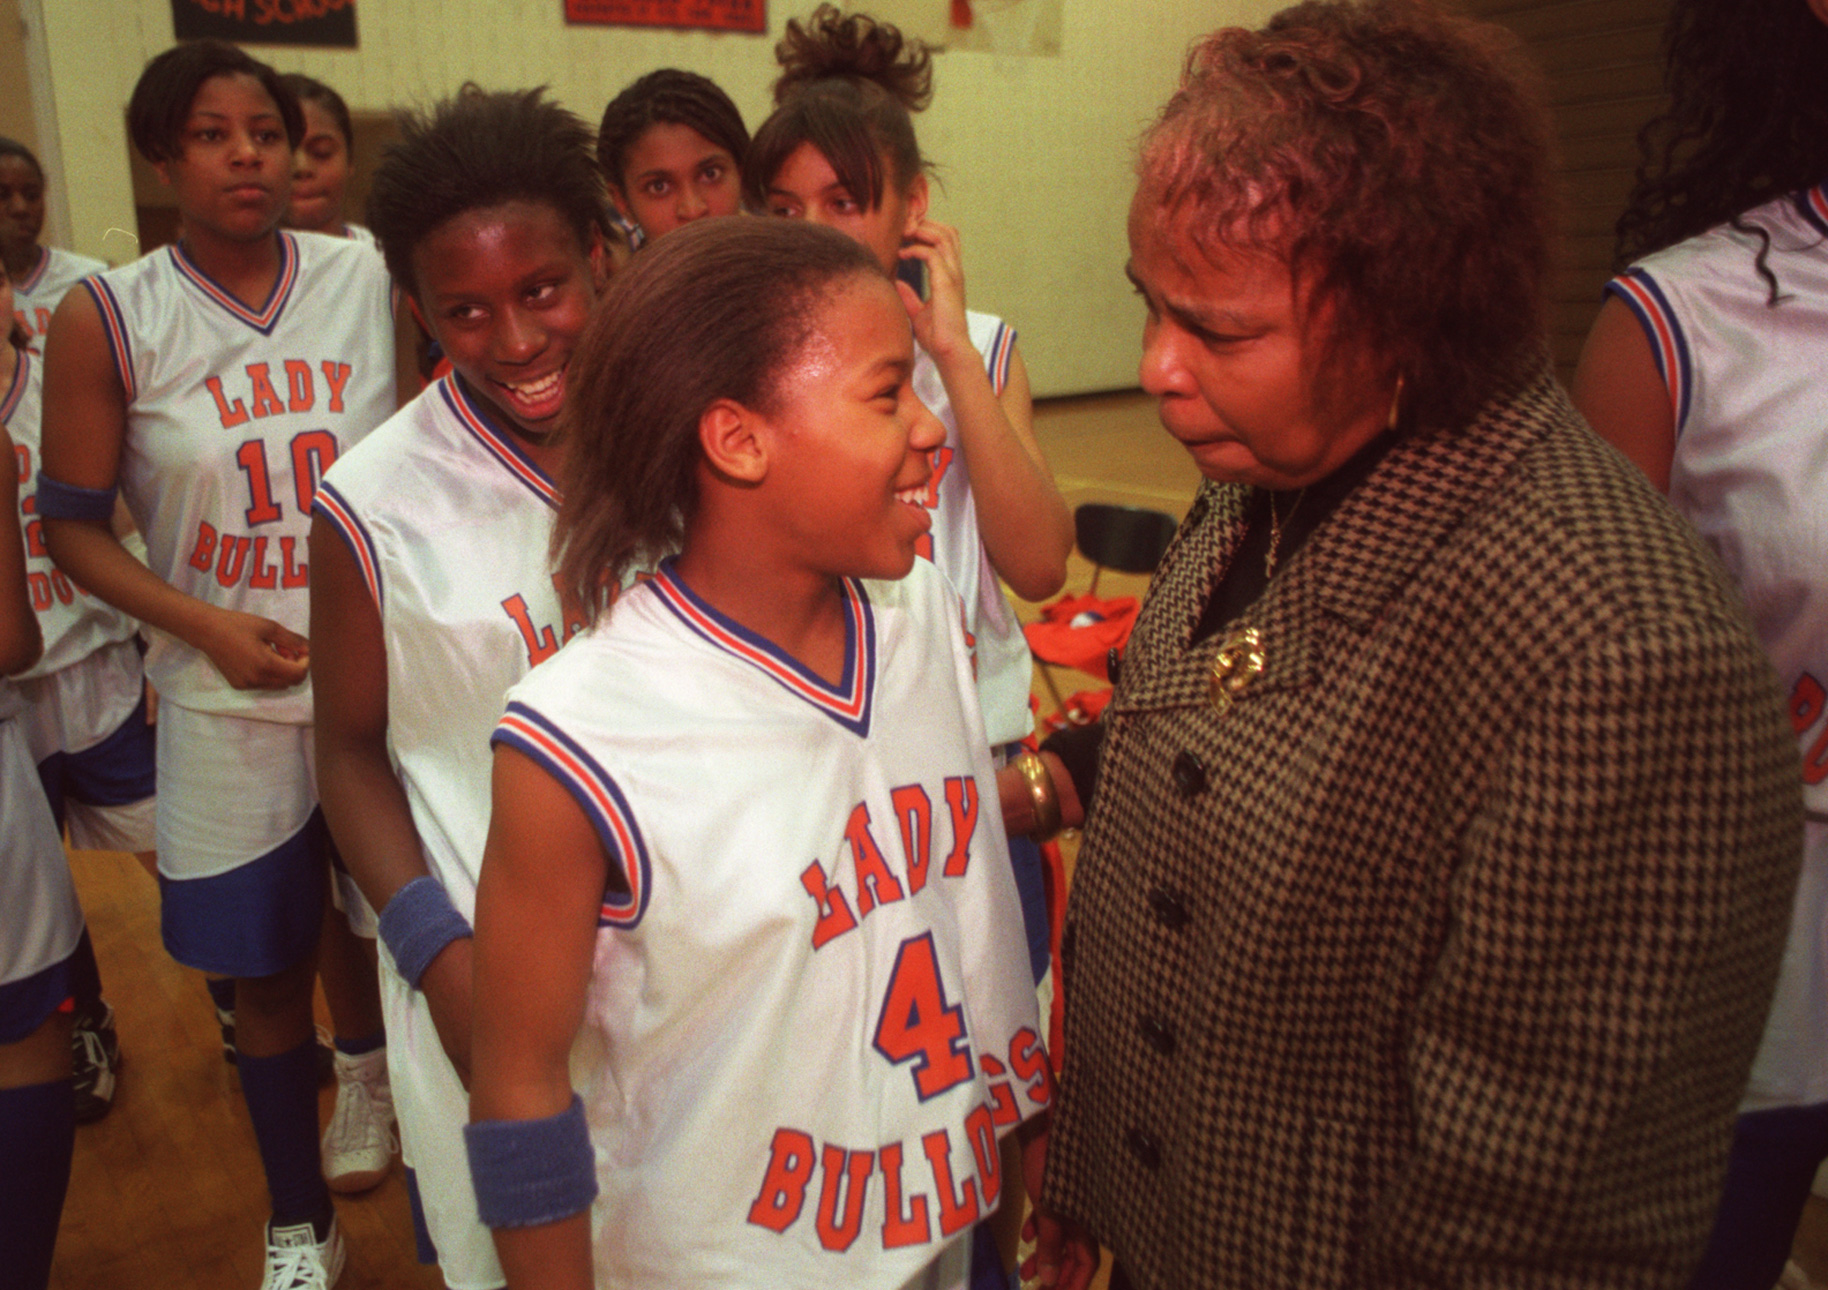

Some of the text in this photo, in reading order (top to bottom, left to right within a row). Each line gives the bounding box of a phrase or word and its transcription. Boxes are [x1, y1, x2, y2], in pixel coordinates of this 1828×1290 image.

[205, 359, 352, 429] LADY
[236, 429, 340, 529] 10
[188, 520, 309, 590] BULL
[800, 776, 979, 951] LADY
[872, 930, 975, 1104] 4
[746, 1026, 1051, 1253] BULLDGS
